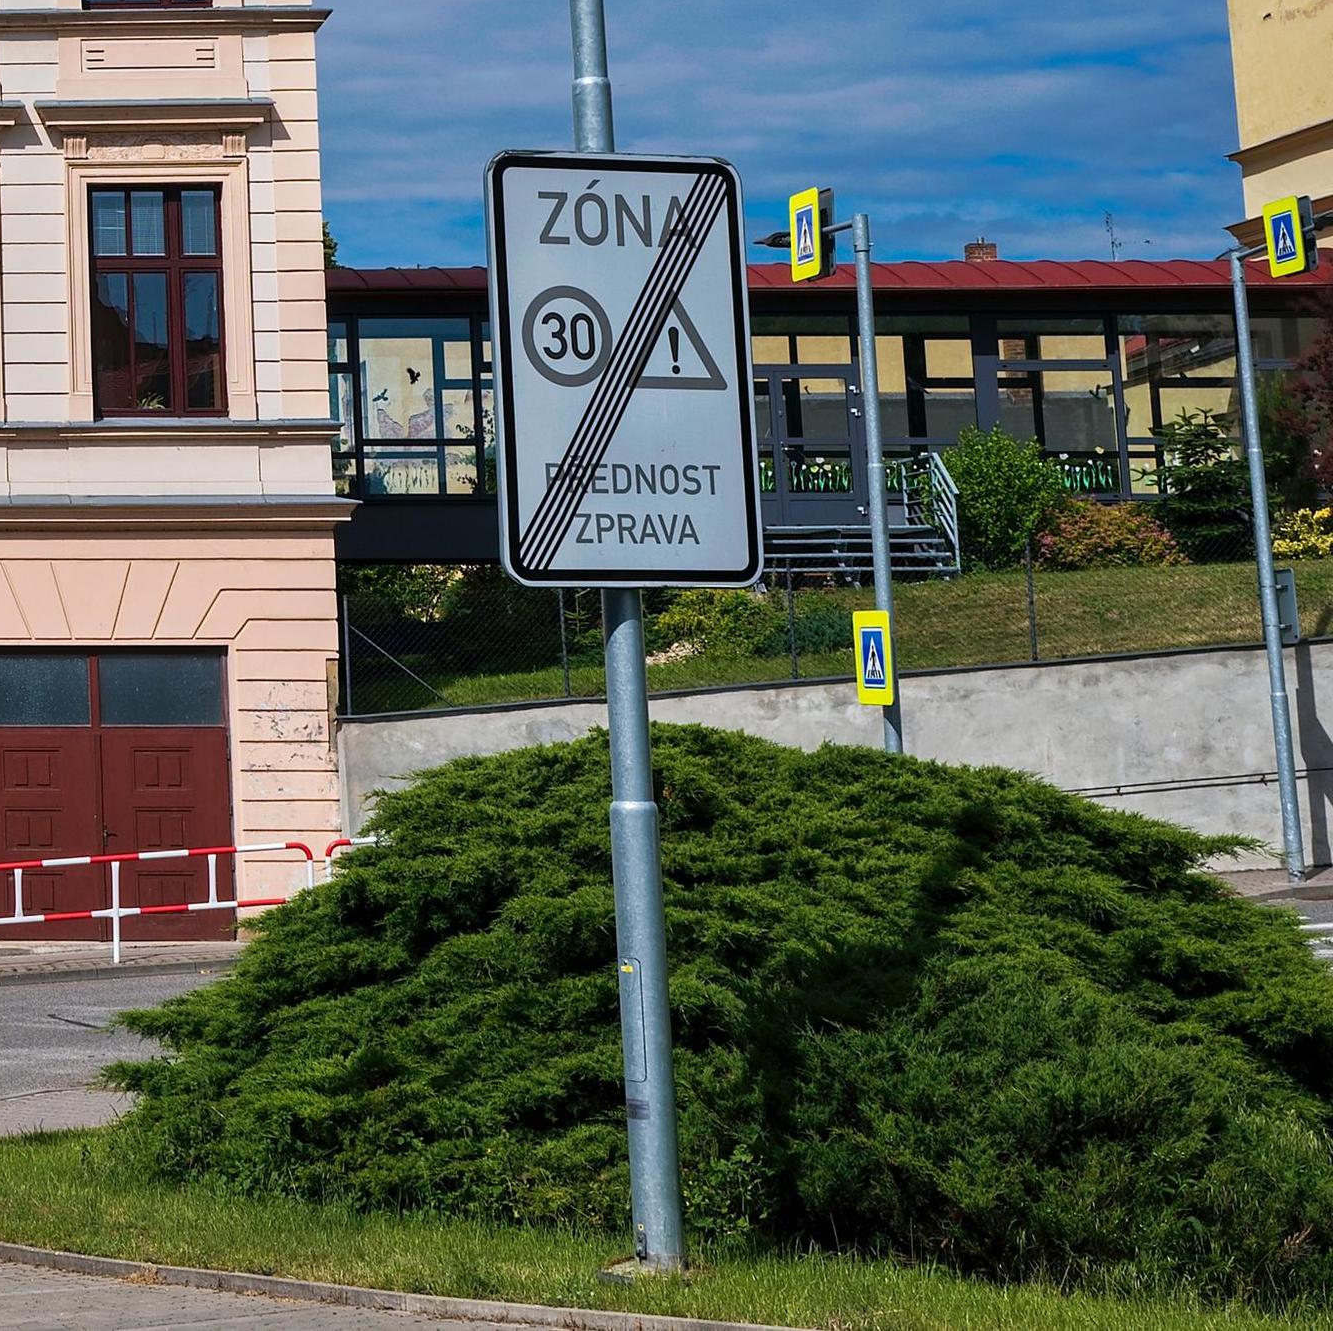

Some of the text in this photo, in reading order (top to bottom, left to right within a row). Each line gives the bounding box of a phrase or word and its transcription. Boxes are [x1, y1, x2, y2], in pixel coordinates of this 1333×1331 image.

[537, 179, 698, 248] ZÓNA
[541, 311, 596, 361] 30
[544, 455, 721, 496] PŘEDNOST
[574, 513, 701, 545] ZPRAVA
